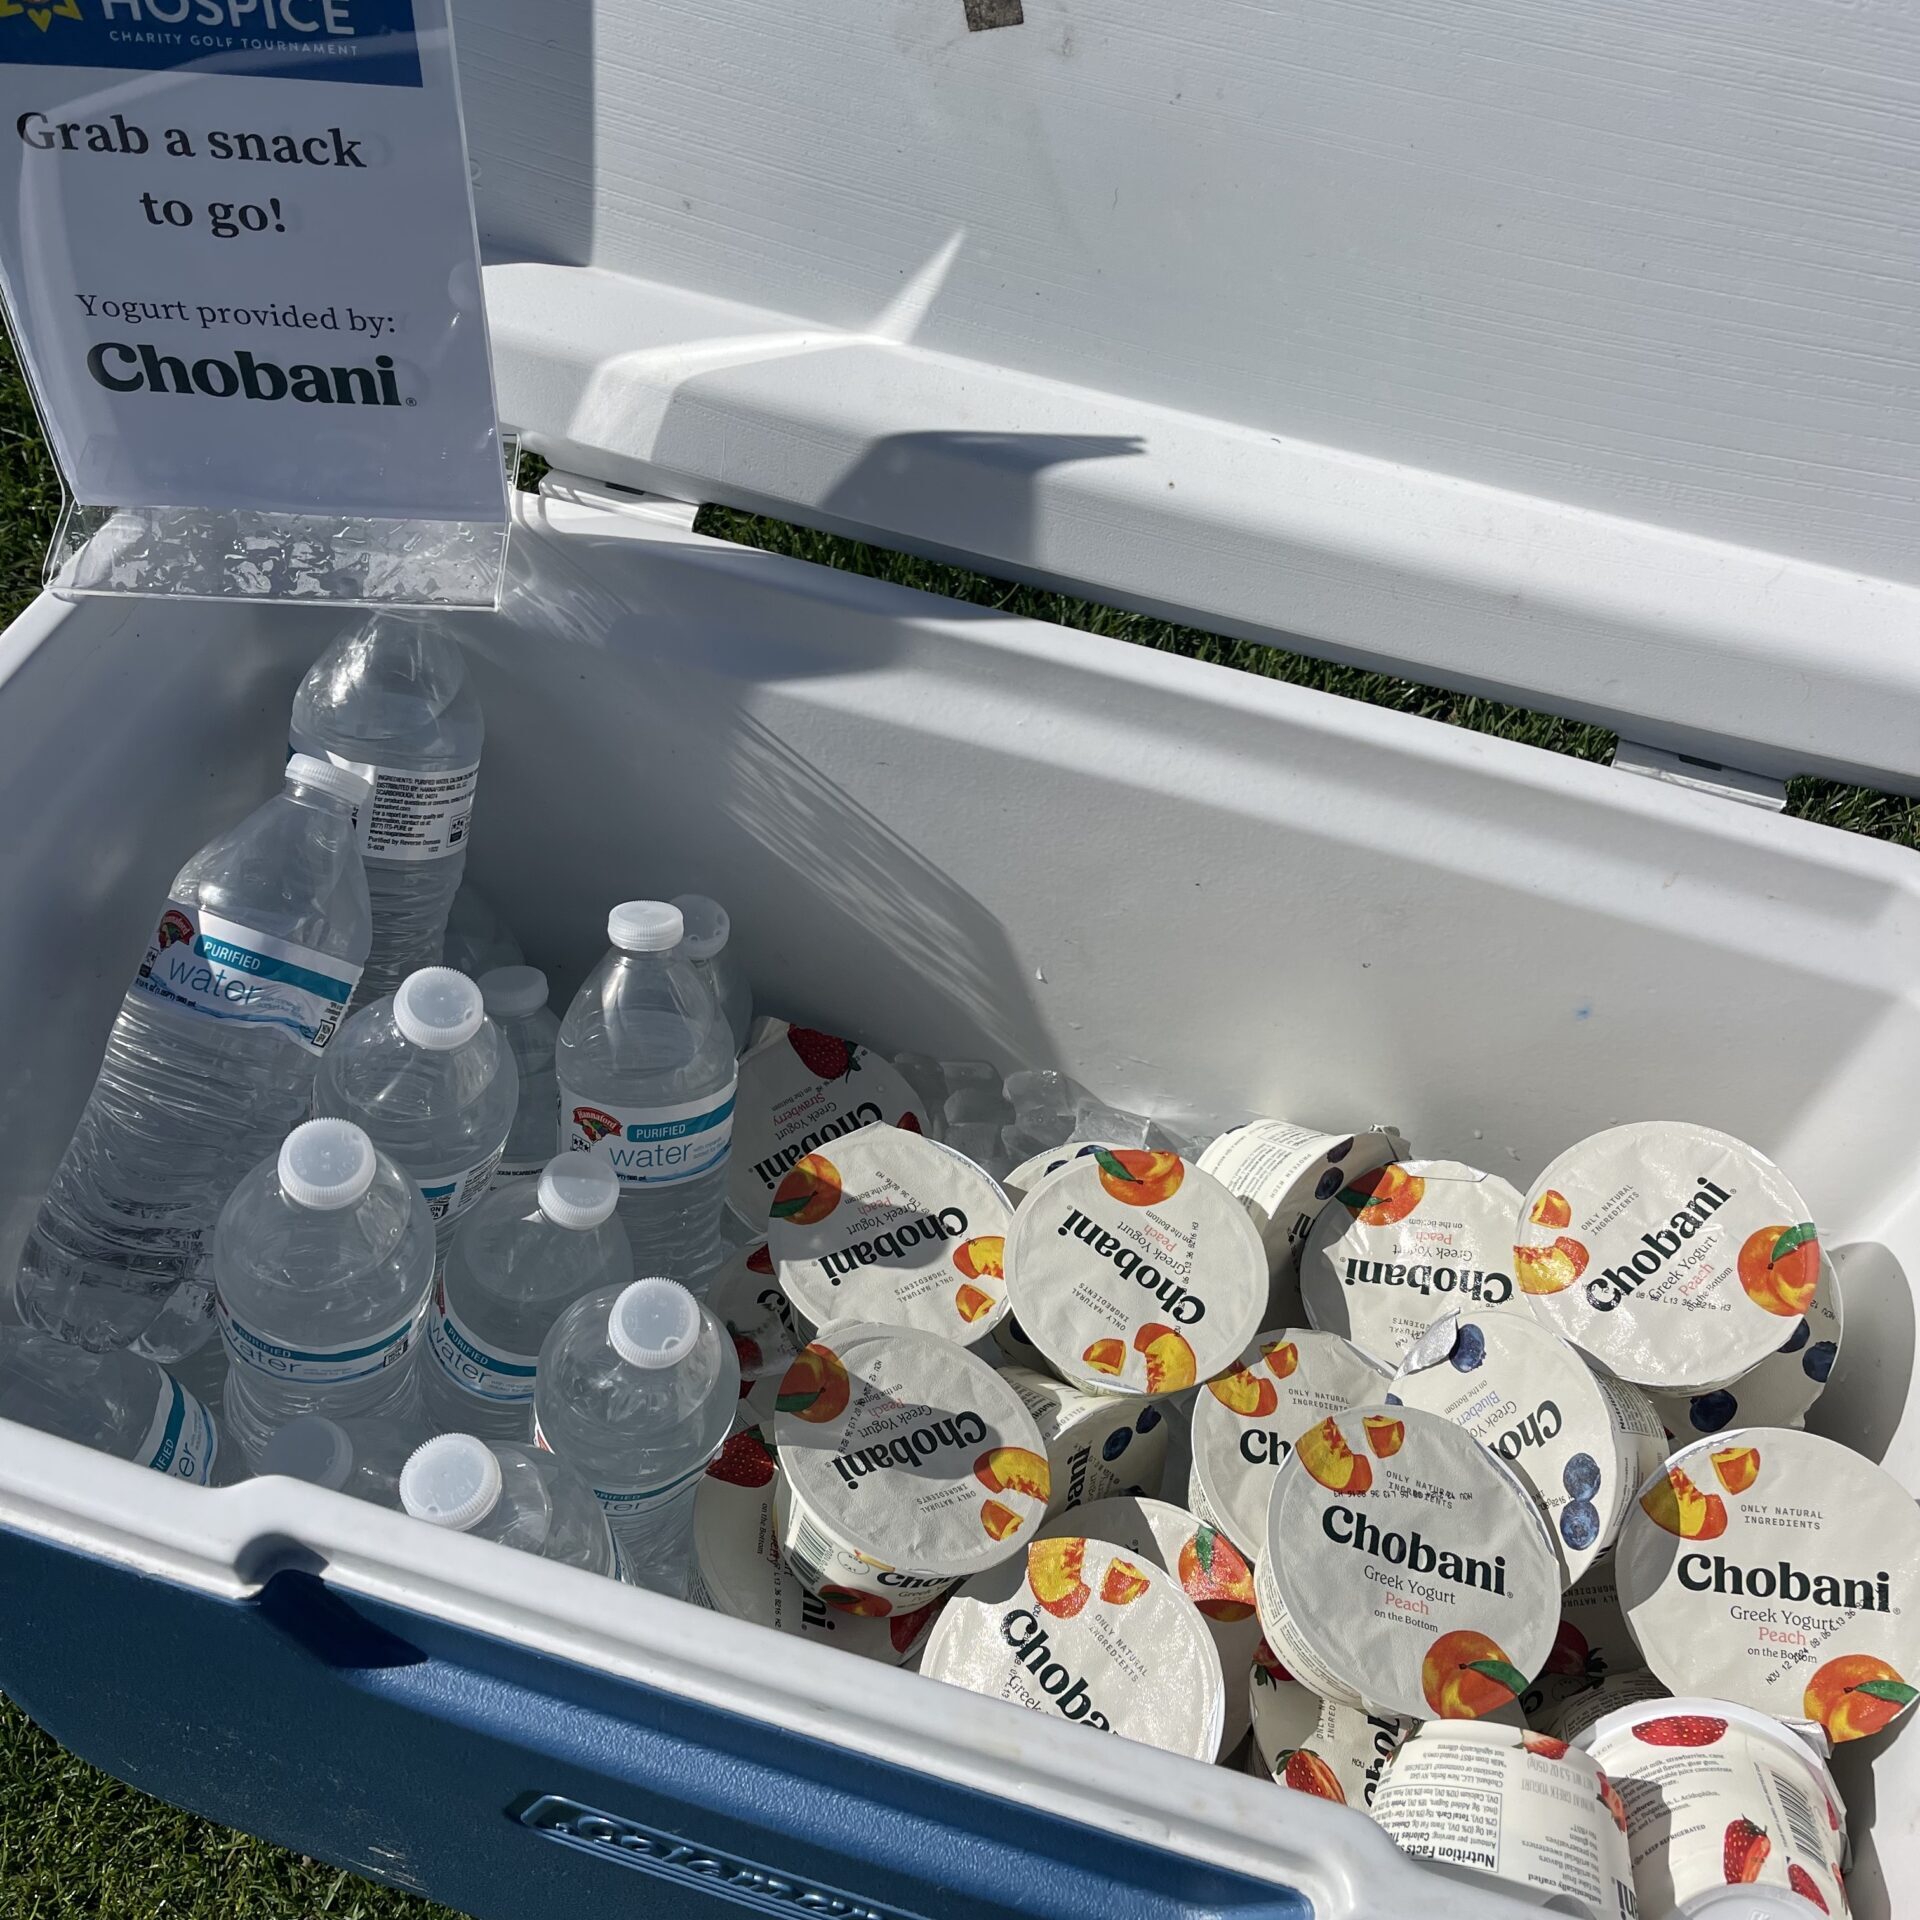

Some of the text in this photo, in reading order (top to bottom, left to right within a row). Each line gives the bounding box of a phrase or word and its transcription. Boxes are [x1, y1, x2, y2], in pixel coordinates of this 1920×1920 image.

[110, 30, 358, 56] CHARITY GOLF TOURNAMENT
[16, 112, 366, 168] Grab a snack
[140, 192, 286, 238] to go!
[76, 294, 396, 338] Yogurt provided by:
[87, 342, 402, 406] Chobani
[369, 836, 390, 844] Purified
[204, 942, 260, 970] PURIFIED
[170, 958, 262, 1005] water
[577, 1109, 616, 1129] Hannaford
[773, 1090, 826, 1126] Strawberry
[774, 1101, 837, 1141] Greek Yogurt
[636, 1124, 686, 1138] PURIFIED
[609, 1143, 693, 1168] water
[844, 1186, 882, 1204] the Bottom
[857, 1196, 892, 1216] Peach
[1580, 1184, 1633, 1231] ONLY NATURAL
[846, 1200, 918, 1236] Greek Yogurt
[1145, 1210, 1182, 1238] the Bottom
[1590, 1192, 1640, 1235] INGREDIENTS
[818, 1207, 968, 1286] Chobani
[1117, 1221, 1186, 1275] Greek Yogurt
[1144, 1224, 1177, 1252] Peach
[1416, 1232, 1452, 1244] Peach
[1584, 1177, 1731, 1312] Chobani
[1058, 1209, 1206, 1324] Chobani
[1436, 1247, 1472, 1261] Greek
[894, 1269, 946, 1295] INGREDIENTS
[1344, 1258, 1512, 1305] Chobani
[1648, 1236, 1718, 1302] Greek Yogurt
[1678, 1264, 1714, 1296] Peach
[1705, 1267, 1733, 1291] Bottom
[897, 1276, 954, 1303] ONLY NATURAL
[1078, 1282, 1129, 1322] INGREDIENTS
[1072, 1288, 1126, 1330] ONLY NATURAL
[432, 1319, 493, 1384] water
[447, 1329, 489, 1365] PURIFIED
[880, 1383, 903, 1397] on the
[1288, 1388, 1350, 1404] ONLY NATURAL
[1444, 1379, 1488, 1415] on the Bottom
[868, 1397, 906, 1418] Peach
[1484, 1400, 1517, 1427] Greek
[857, 1405, 932, 1438] Greek Yogurt
[831, 1411, 986, 1490] Chobani
[1386, 1470, 1410, 1483] ONLY
[916, 1482, 967, 1505] INGREDIENTS
[920, 1490, 976, 1514] ONLY NATURAL
[1740, 1504, 1823, 1520] ONLY NATURAL
[1744, 1515, 1820, 1530] INGREDIENTS
[757, 1502, 768, 1554] on the Bottom
[1322, 1505, 1506, 1596] Chobani
[1364, 1565, 1456, 1605] Greek Yogurt
[1677, 1553, 1891, 1613] Chobani
[1385, 1591, 1429, 1615] Peach
[1374, 1610, 1438, 1632] on the Bottom
[1730, 1605, 1834, 1634] Greek Yogurt
[1094, 1614, 1148, 1676] ONLY NATURAL
[1758, 1626, 1806, 1646] Peach
[1782, 1660, 1792, 1671] 12
[1844, 1609, 1856, 1620] 36
[1762, 1648, 1778, 1658] the
[1000, 1609, 1110, 1732] Choba
[1316, 1714, 1325, 1739] ONLY
[1452, 1812, 1469, 1821] Total
[1401, 1832, 1429, 1841] Calories
[1543, 1836, 1589, 1856] preservatives
[1569, 1833, 1588, 1846] gluten
[1659, 1824, 1706, 1846] REFRIGERATED
[1406, 1844, 1495, 1867] Nutrition Facts
[1521, 1840, 1590, 1867] artificial sweeteners
[1538, 1855, 1590, 1878] artificial flavors
[1528, 1873, 1556, 1886] crafted
[1562, 1873, 1577, 1883] fruit
